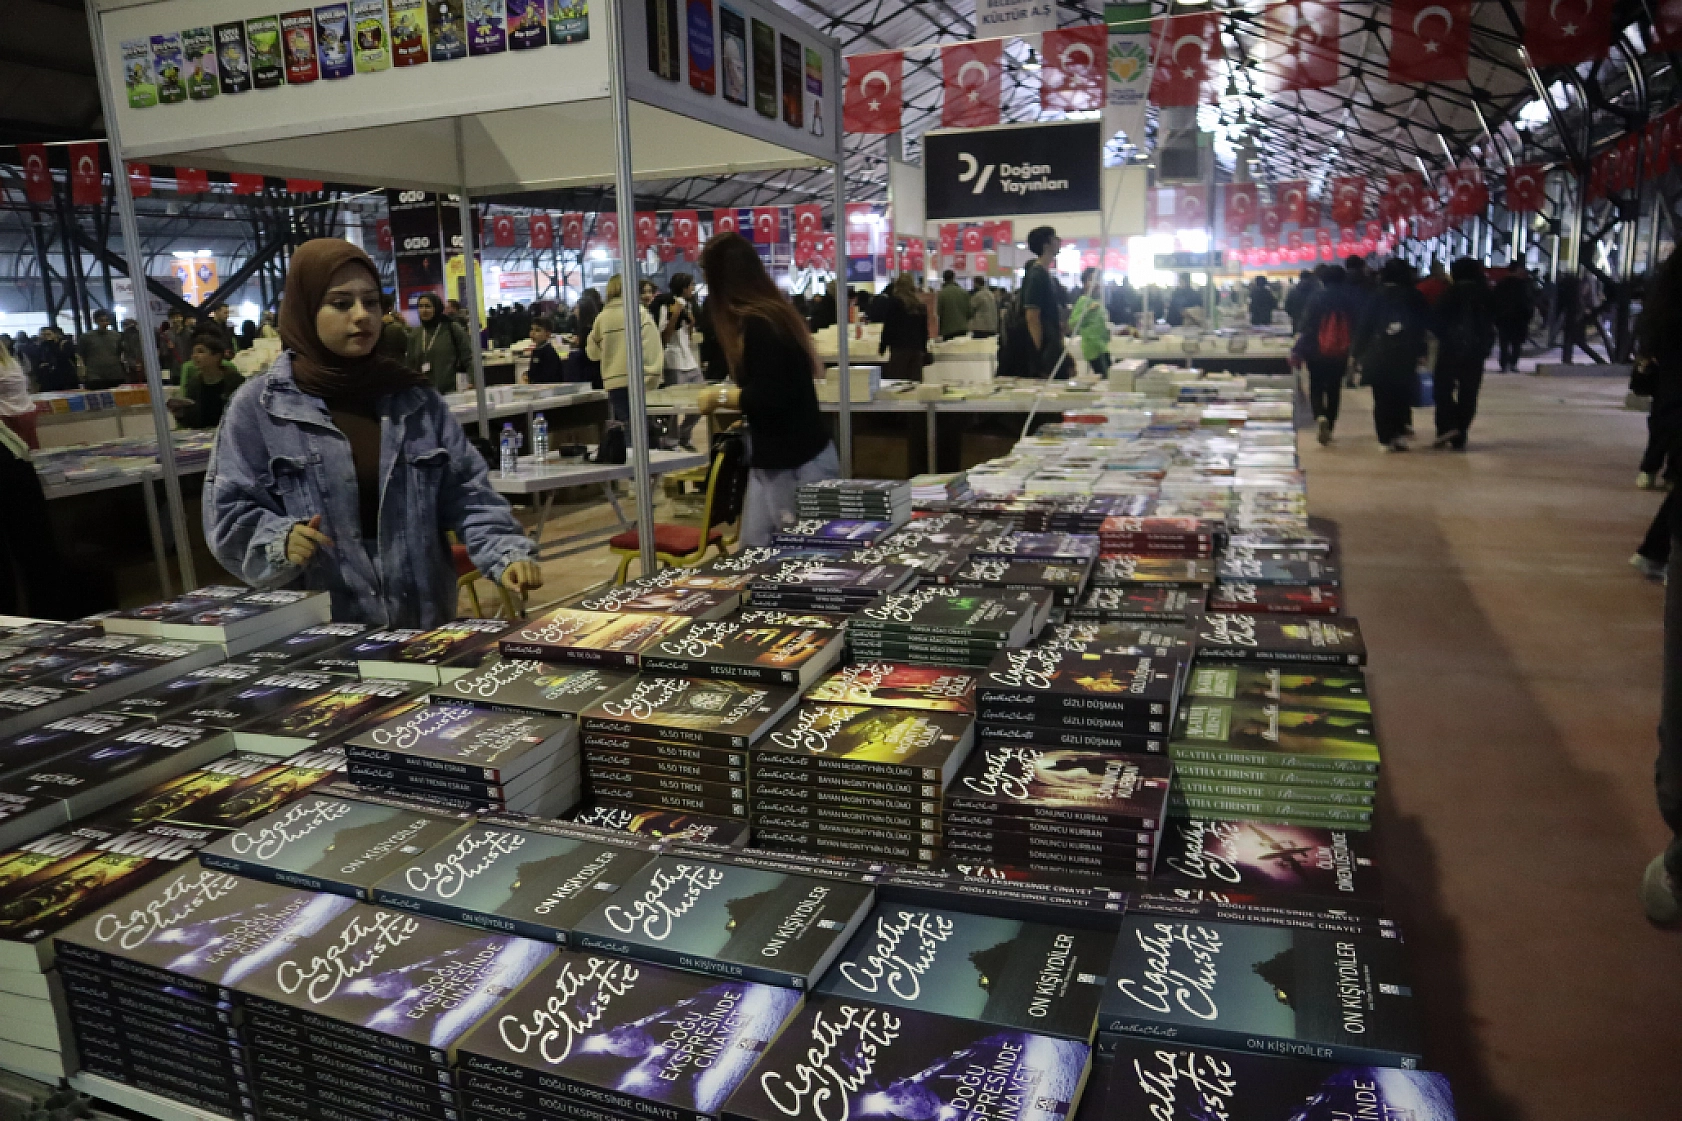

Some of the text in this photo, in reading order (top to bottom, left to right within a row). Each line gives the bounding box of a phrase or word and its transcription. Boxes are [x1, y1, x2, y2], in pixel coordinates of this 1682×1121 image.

[982, 8, 1029, 24] KÜLTÜR
[1000, 177, 1069, 196] Yayınları
[1001, 163, 1051, 181] Doğan
[710, 665, 761, 678] SESSİZ TANIK
[989, 649, 1032, 687] Agatha
[1025, 647, 1063, 689] Christie
[603, 678, 664, 717] Agatha
[631, 678, 691, 720] Christie
[1062, 697, 1124, 711] GİZLİ DÜŞMAN
[373, 706, 452, 745] Agatha
[397, 708, 473, 749] Christie
[770, 706, 824, 749] Agatha
[804, 707, 856, 752] Christie
[1060, 733, 1122, 748] GİZLİ DÜŞMAN
[1062, 715, 1124, 729] GİZLİ DÜŞMAN
[963, 747, 1013, 796] Agatha
[1001, 747, 1044, 800] Christie
[1216, 768, 1267, 782] CHRISTIE
[1218, 752, 1267, 766] CHRISTIE
[231, 800, 329, 854] Agatha
[256, 802, 351, 860] Christie
[1029, 822, 1103, 838] SONUNCU KURBAN
[1034, 808, 1109, 823] SONUNCU KURBAN
[18, 832, 95, 860] KIN
[95, 831, 208, 861] KING
[340, 819, 431, 874] ON KİŞİYDİLER
[406, 831, 499, 891] Agatha
[437, 833, 526, 898] Christie
[1029, 836, 1103, 852] SONUNCU KURBAN
[95, 870, 216, 943] Agatha
[534, 851, 618, 914] ON KİŞİYDİLER
[605, 864, 692, 933] Agatha
[643, 865, 724, 941] Christie
[121, 873, 238, 949] Christie
[462, 912, 477, 924] ON
[761, 886, 831, 957] ON KİŞİYDİLER
[1217, 911, 1244, 921] DOĞU
[1318, 922, 1363, 935] CİNAYET
[277, 911, 391, 994] Agatha
[308, 913, 420, 1004] Christie
[679, 957, 742, 977] ON KİŞİYDİLER
[839, 911, 914, 992] Agatha
[887, 912, 954, 1001] Christie
[1035, 933, 1075, 997] KİŞİYDİLER
[1117, 922, 1173, 1013] Agatha
[1176, 923, 1224, 1020] Christie
[406, 943, 504, 1020] EKSPRESİNDE
[421, 960, 463, 993] DOĞU
[1335, 941, 1366, 1035] ON KİŞİYDİLER
[499, 957, 604, 1053] Agatha
[541, 959, 640, 1064] Christie
[1028, 997, 1050, 1018] ON
[659, 990, 742, 1082] EKSPRESİNDE
[662, 1010, 703, 1050] DOĞU
[694, 1009, 744, 1069] CİNAYET
[1246, 1038, 1333, 1059] ON KİŞİYDİLER
[761, 1005, 859, 1116] Agatha
[813, 1008, 901, 1121] Christie
[967, 1041, 1023, 1121] PRESİNDE
[539, 1076, 679, 1121] DOĞU EKSPRESİNDE CİNAYET
[950, 1063, 987, 1111] DOĞU
[991, 1064, 1037, 1121] İNAYET
[1133, 1050, 1178, 1121] atha
